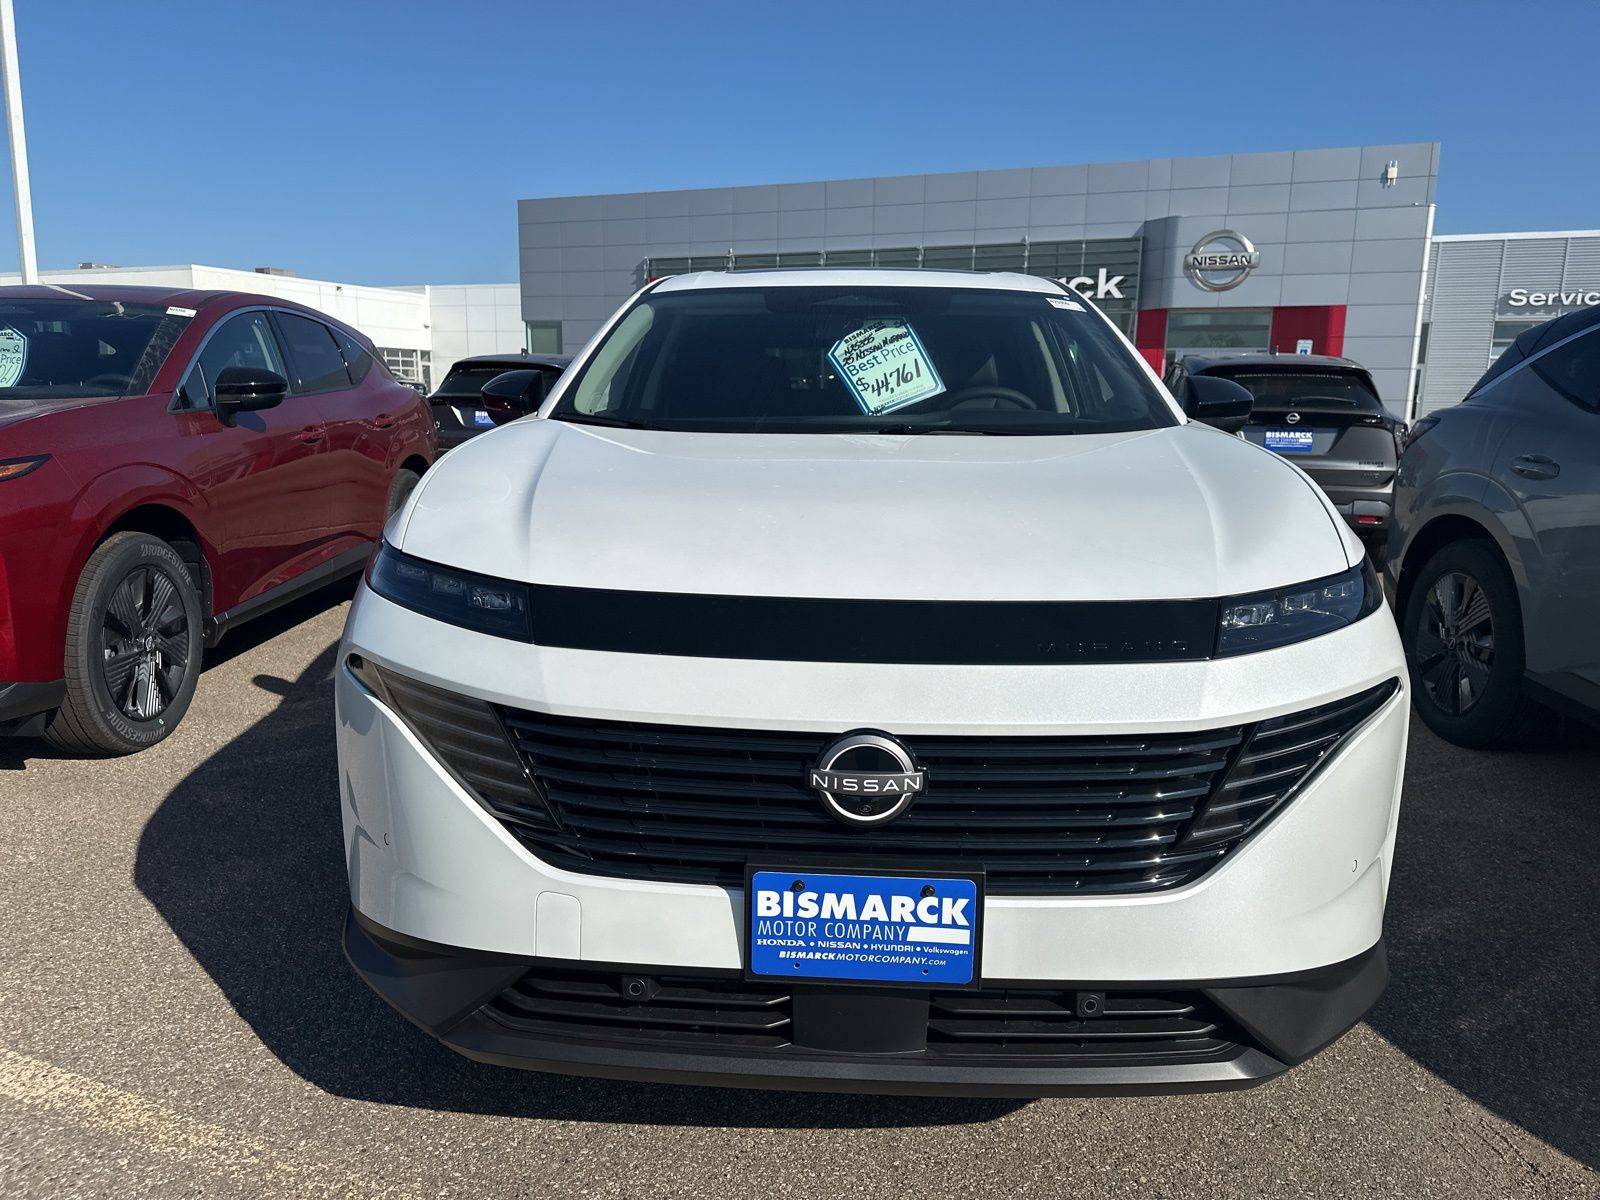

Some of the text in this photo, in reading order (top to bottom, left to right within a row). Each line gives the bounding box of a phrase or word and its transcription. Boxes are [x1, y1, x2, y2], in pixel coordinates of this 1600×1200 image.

[1192, 254, 1252, 267] NISSAN
[844, 321, 885, 344] BISMARCK
[1, 354, 21, 365] Price
[846, 342, 915, 377] Best Price
[1265, 431, 1313, 439] BISMARCK
[140, 543, 193, 586] BRIDGESTONE
[812, 773, 920, 792] NISSAN
[757, 890, 970, 926] BISMARCK
[758, 920, 907, 942] MOTOR COMPANY
[757, 938, 969, 956] HONDA NISSAN HYUNDAI Volkswagen
